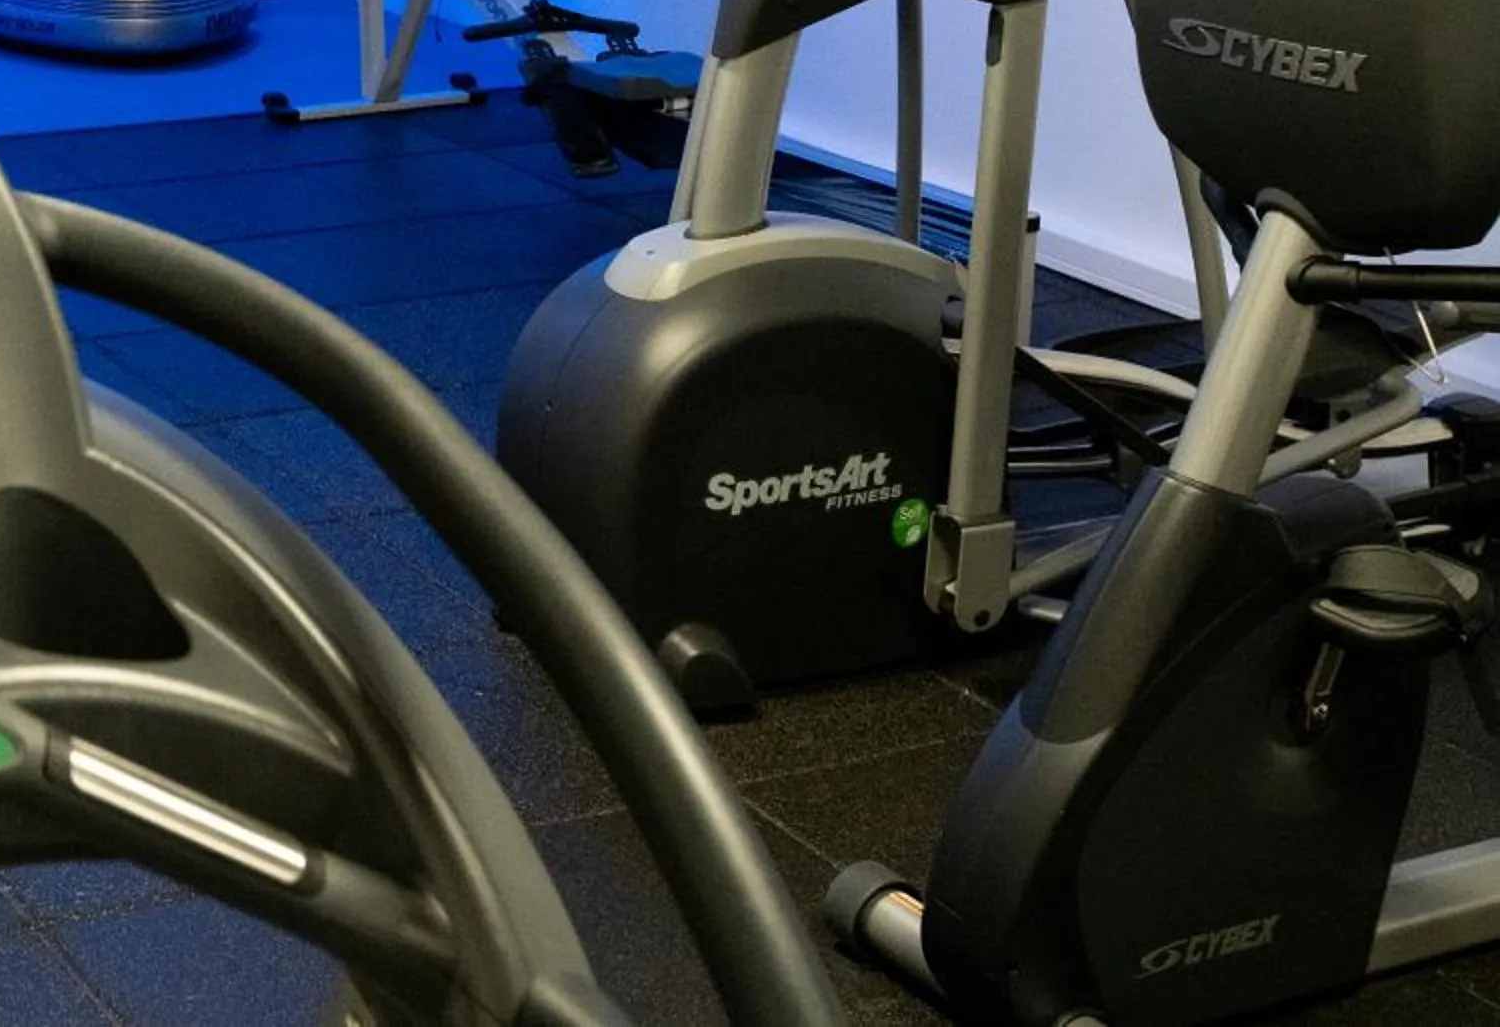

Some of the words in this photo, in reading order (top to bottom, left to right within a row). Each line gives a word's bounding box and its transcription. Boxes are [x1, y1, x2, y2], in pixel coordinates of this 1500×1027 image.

[1220, 27, 1368, 93] CYBEX
[705, 451, 892, 515] SportsArt
[825, 484, 902, 511] FITNESS
[1184, 913, 1281, 966] CYBEX
